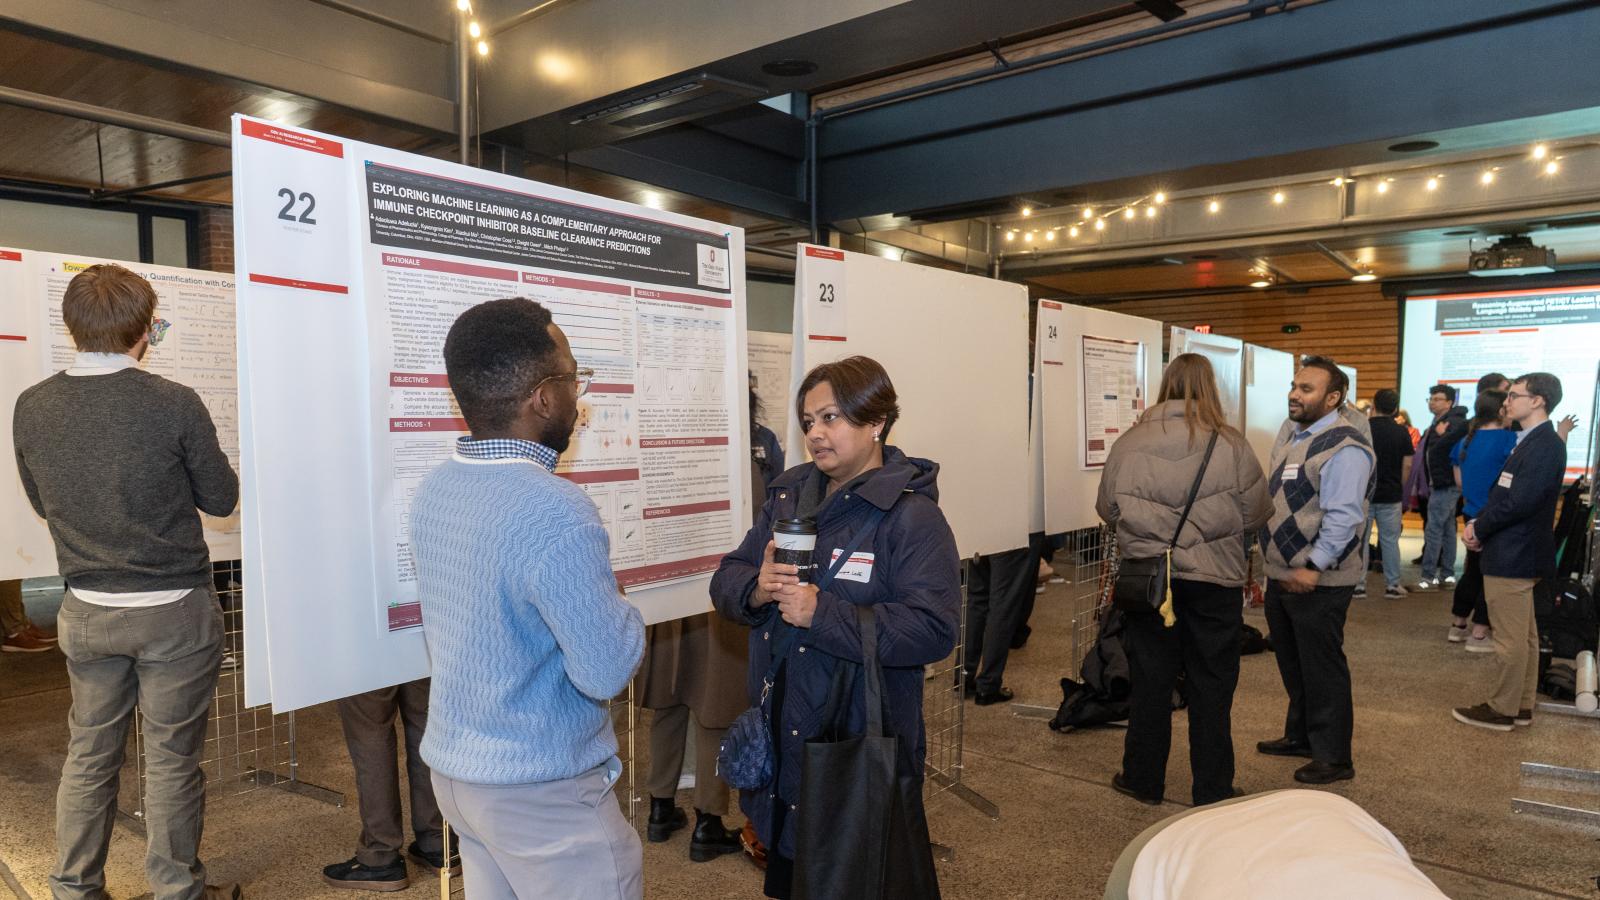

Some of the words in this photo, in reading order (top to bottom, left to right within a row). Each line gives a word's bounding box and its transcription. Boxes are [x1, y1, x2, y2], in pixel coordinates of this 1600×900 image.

[277, 187, 317, 225] 22
[372, 182, 430, 202] EXPLORING
[432, 194, 474, 211] MACHINE
[475, 202, 519, 219] LEARNING
[520, 209, 532, 220] AS
[533, 212, 540, 222] A
[541, 214, 608, 236] COMPLEMENTARY
[608, 226, 647, 243] APPROACH
[647, 234, 661, 245] FOR
[373, 198, 414, 215] IMMUNE
[416, 206, 475, 226] CHECKPOINT
[476, 216, 519, 234] INHIBITOR
[521, 225, 559, 241] BASELINE
[560, 231, 605, 248] CLEARANCE
[606, 239, 651, 256] PREDICTIONS
[386, 255, 421, 266] RATIONALE
[64, 264, 87, 273] Towa
[150, 273, 202, 284] Quantification
[221, 280, 235, 288] Con
[525, 274, 548, 282] METHODS
[819, 283, 835, 303] 23
[1048, 325, 1057, 339] 24
[393, 376, 429, 384] OBJECTIVES
